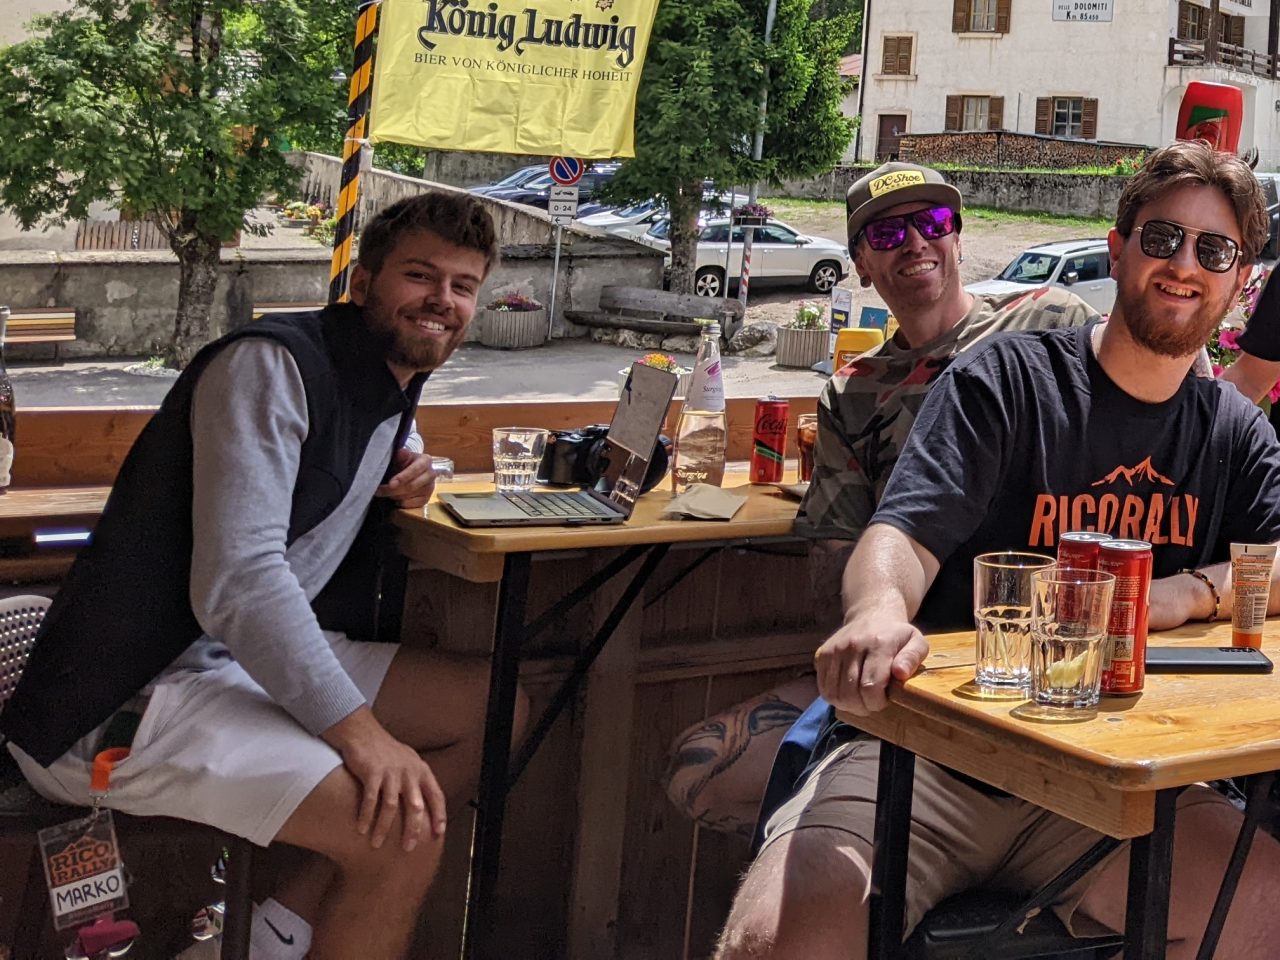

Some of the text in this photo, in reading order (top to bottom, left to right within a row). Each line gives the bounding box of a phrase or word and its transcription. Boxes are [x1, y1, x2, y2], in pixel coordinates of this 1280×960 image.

[1074, 2, 1108, 11] DOLOMITI
[513, 7, 636, 68] Ludwig
[414, 52, 632, 82] BIER VON KÖNIGLICHER HOHEIT
[1028, 492, 1199, 548] RICO RALY
[53, 842, 110, 872] RICO
[57, 857, 111, 881] RALLY
[56, 875, 120, 912] MARKO
